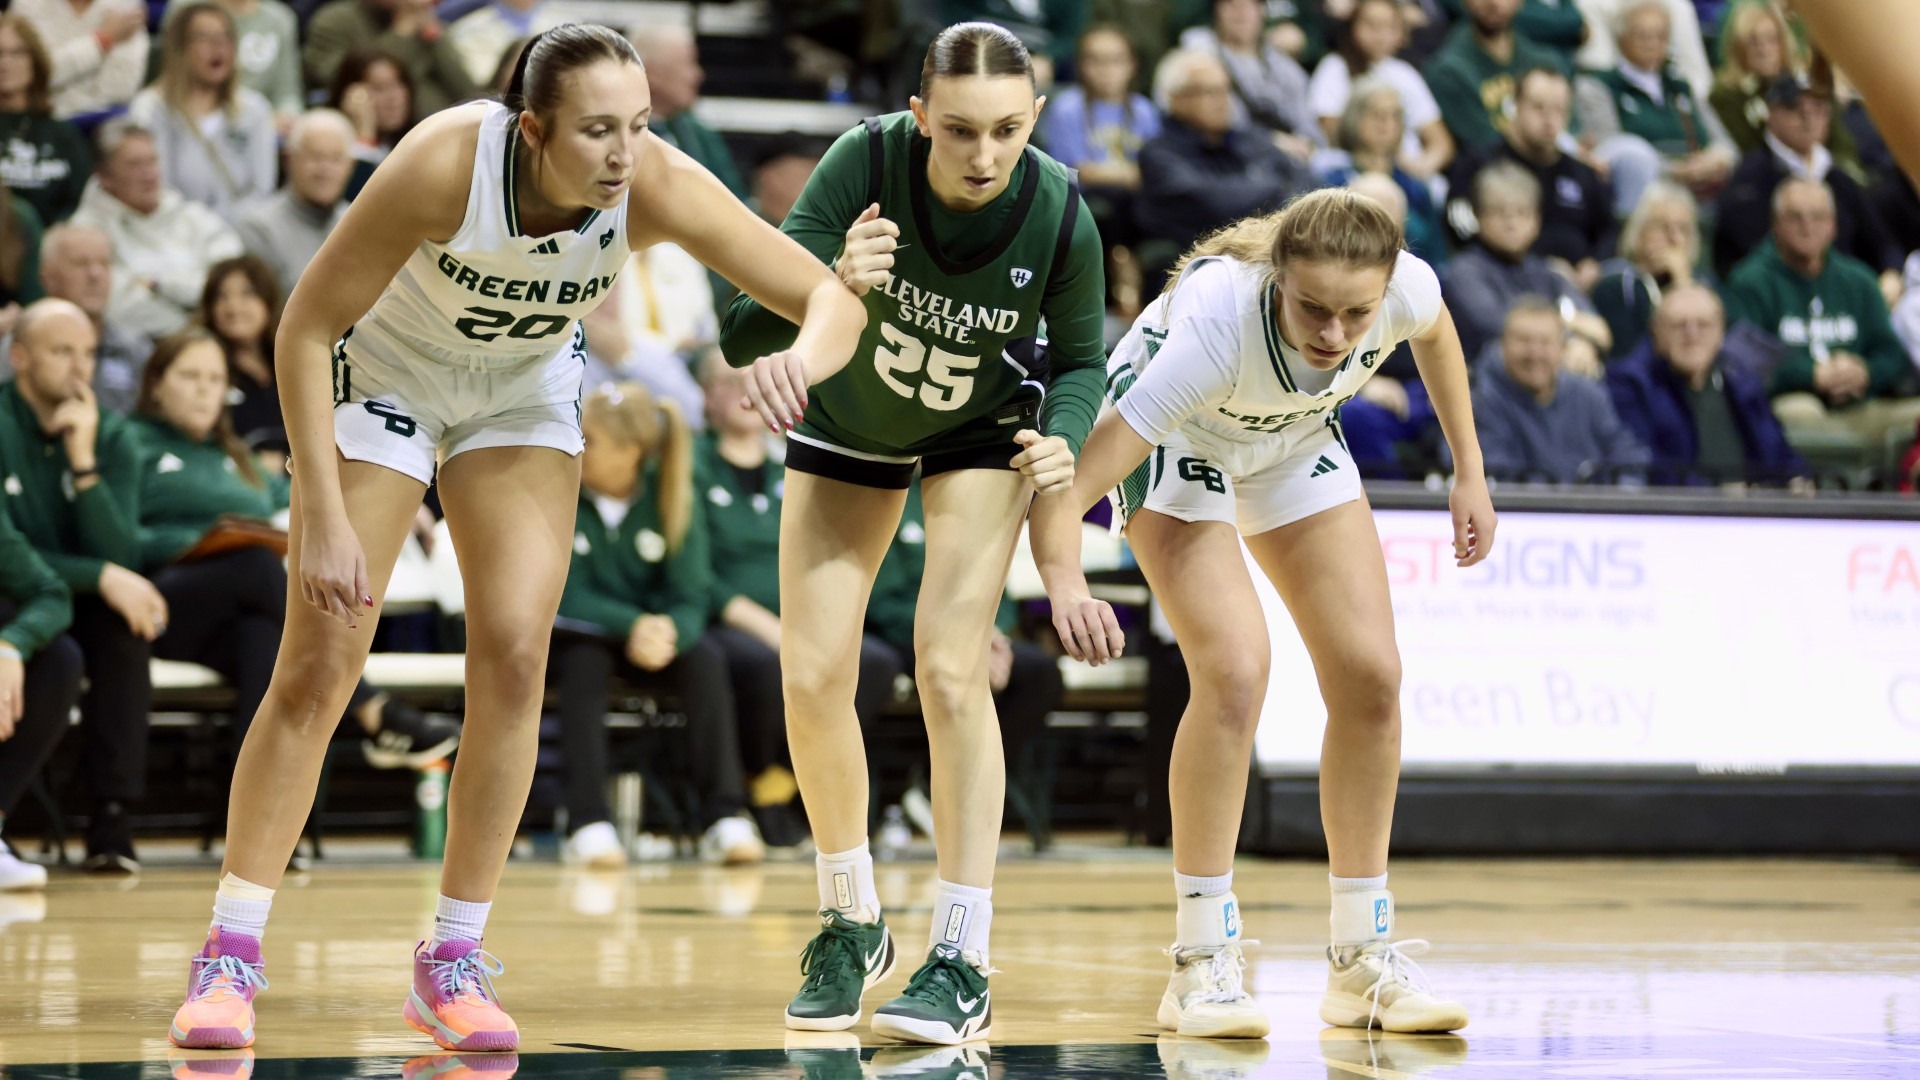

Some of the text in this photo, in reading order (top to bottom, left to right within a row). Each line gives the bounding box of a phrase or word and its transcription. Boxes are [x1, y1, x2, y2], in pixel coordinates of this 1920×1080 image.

[437, 252, 617, 305] GREEN BAY
[873, 273, 1020, 334] LEVELAND
[455, 306, 571, 342] 20
[898, 303, 971, 344] STATE
[874, 322, 981, 412] 25
[1177, 457, 1226, 494] GB
[1544, 667, 1656, 747] Bay
